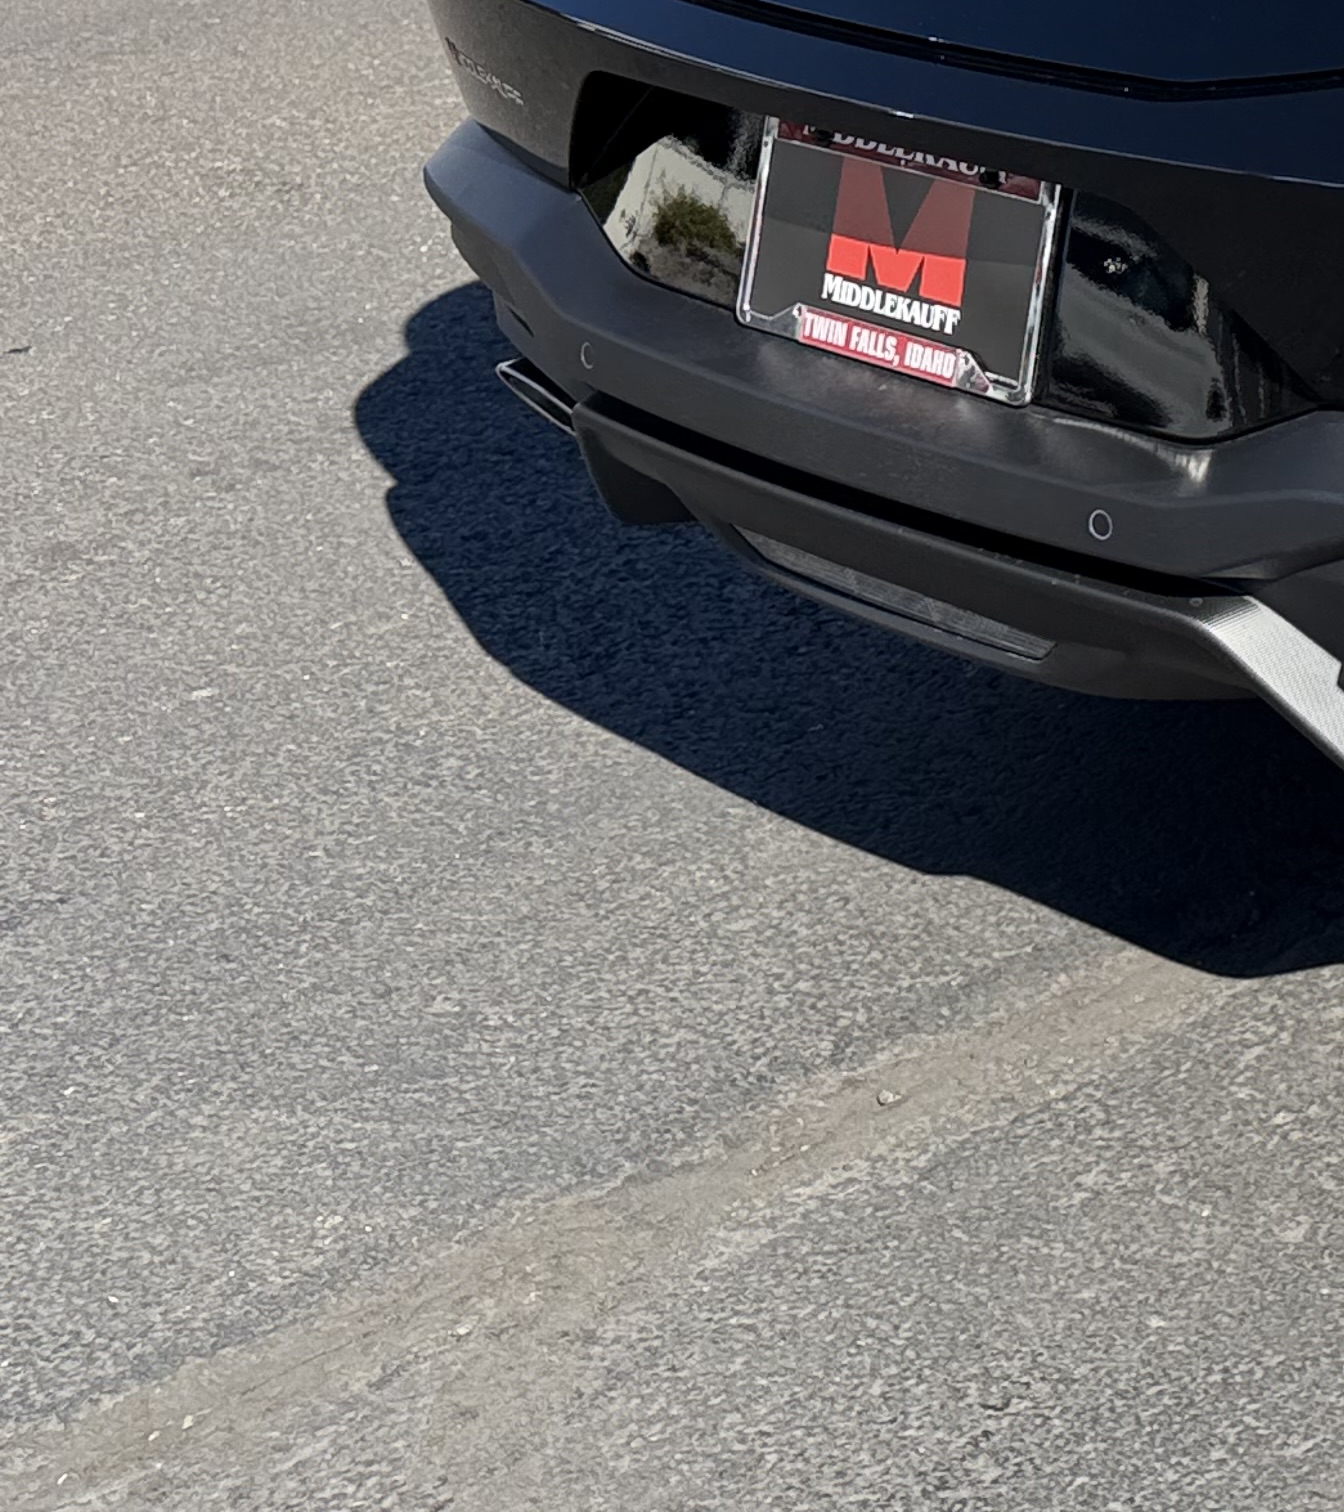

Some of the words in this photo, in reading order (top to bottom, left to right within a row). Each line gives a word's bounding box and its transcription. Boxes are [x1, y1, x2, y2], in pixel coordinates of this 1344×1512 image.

[821, 273, 962, 335] MIDDLEKAUFF
[803, 312, 849, 347] TWIN
[850, 325, 900, 366] FALLS,
[904, 341, 957, 379] IDAHO
